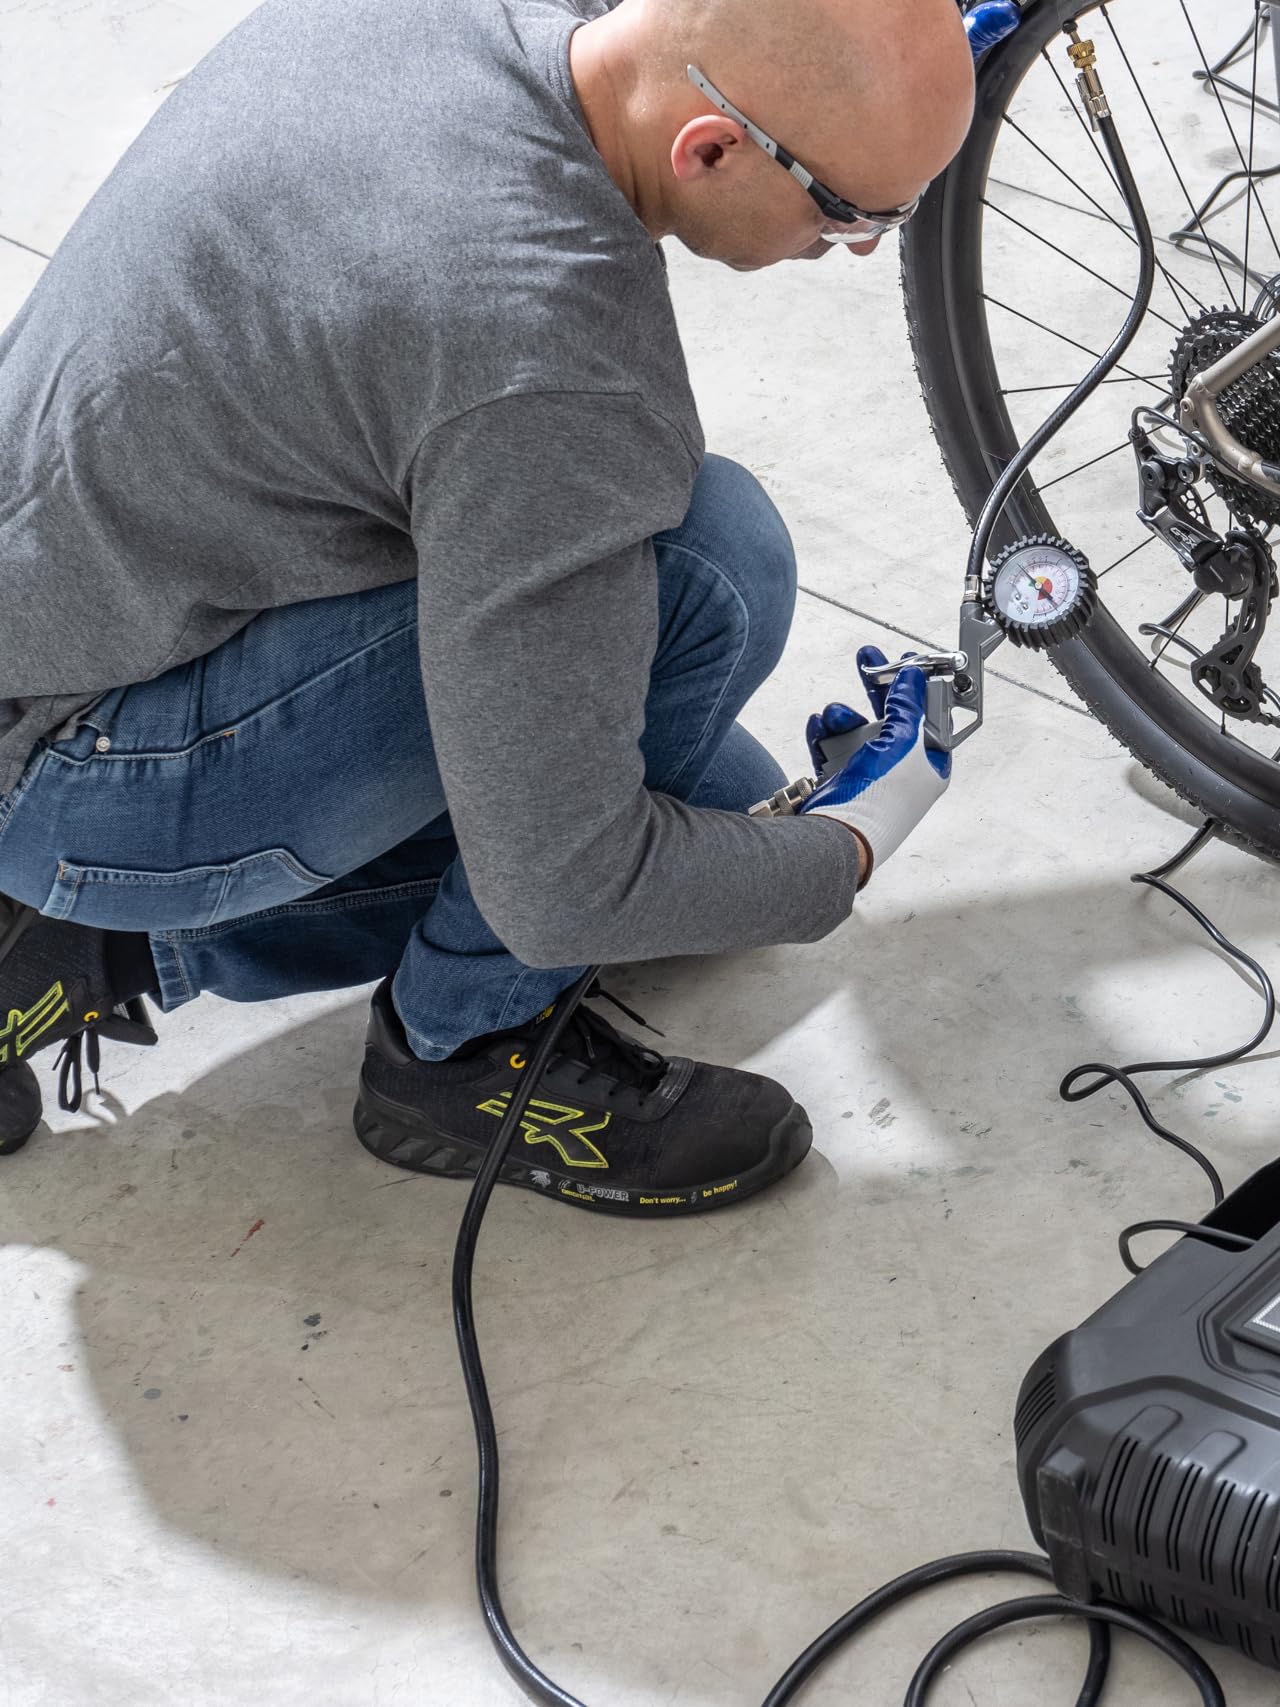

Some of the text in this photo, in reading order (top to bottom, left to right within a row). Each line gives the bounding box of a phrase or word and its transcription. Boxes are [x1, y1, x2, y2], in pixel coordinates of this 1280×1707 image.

[576, 1183, 630, 1202] U-POWER
[639, 1196, 659, 1204] Don't
[703, 1190, 713, 1198] be
[713, 1179, 738, 1195] happy!
